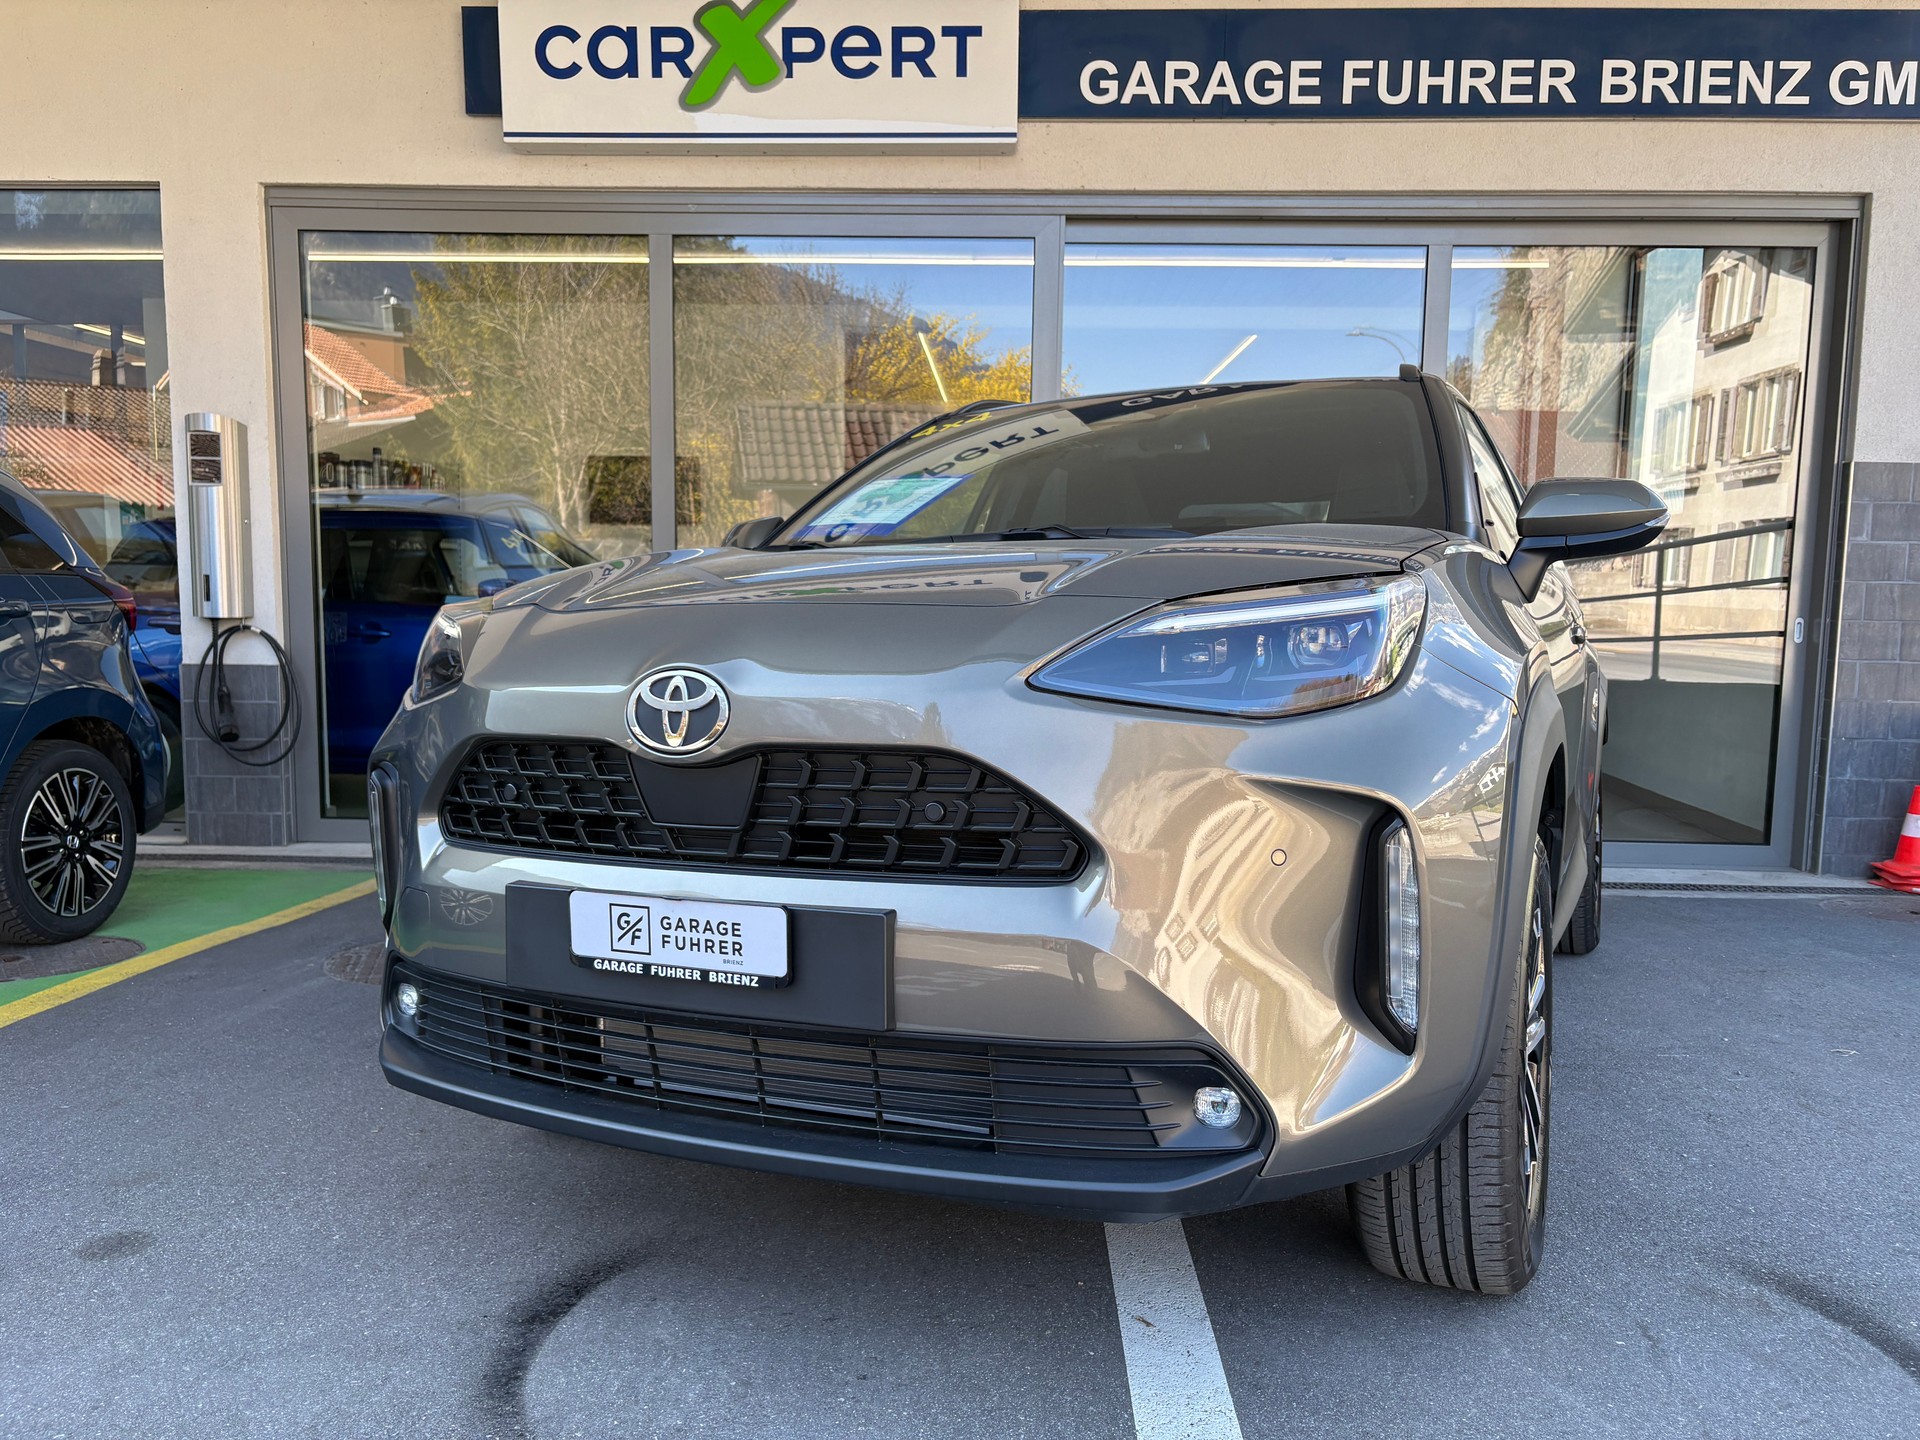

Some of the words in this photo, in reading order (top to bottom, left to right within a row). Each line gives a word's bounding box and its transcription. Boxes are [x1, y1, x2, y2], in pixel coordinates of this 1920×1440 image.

[1079, 59, 1323, 106] GARAGE
[1341, 58, 1577, 105] FUHRER
[1600, 59, 1812, 106] BRIENZ
[660, 915, 742, 938] GARAGE
[661, 934, 743, 957] FUHRER
[593, 958, 644, 974] GARAGE
[650, 965, 702, 981] FUHRER
[708, 971, 759, 987] BRIENZ
[722, 958, 744, 966] BRIENZ
